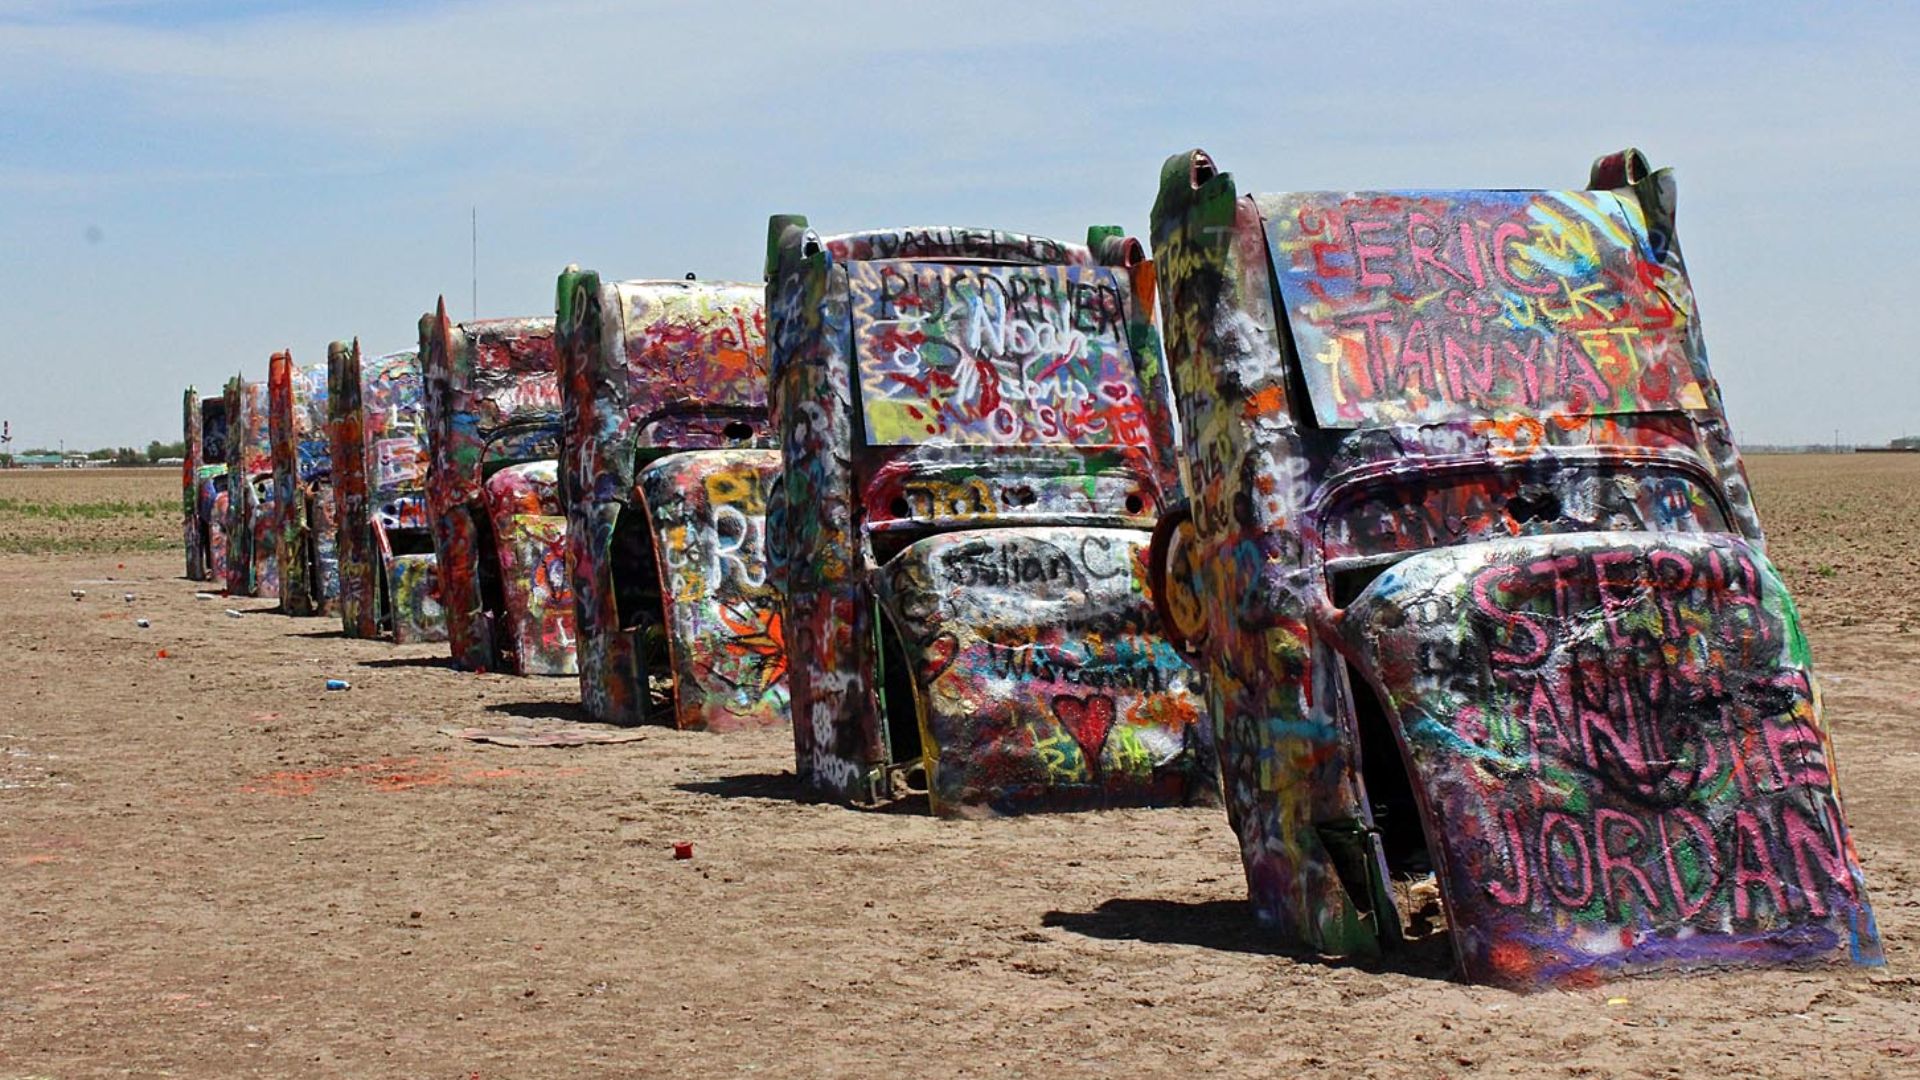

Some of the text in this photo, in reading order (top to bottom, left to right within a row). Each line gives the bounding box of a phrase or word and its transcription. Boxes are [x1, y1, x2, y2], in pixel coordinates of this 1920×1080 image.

[1350, 212, 1559, 296] ERIC
[1335, 310, 1610, 403] TANYA
[1472, 547, 1771, 666] STEPH
[1487, 804, 1867, 919] JORDAN
